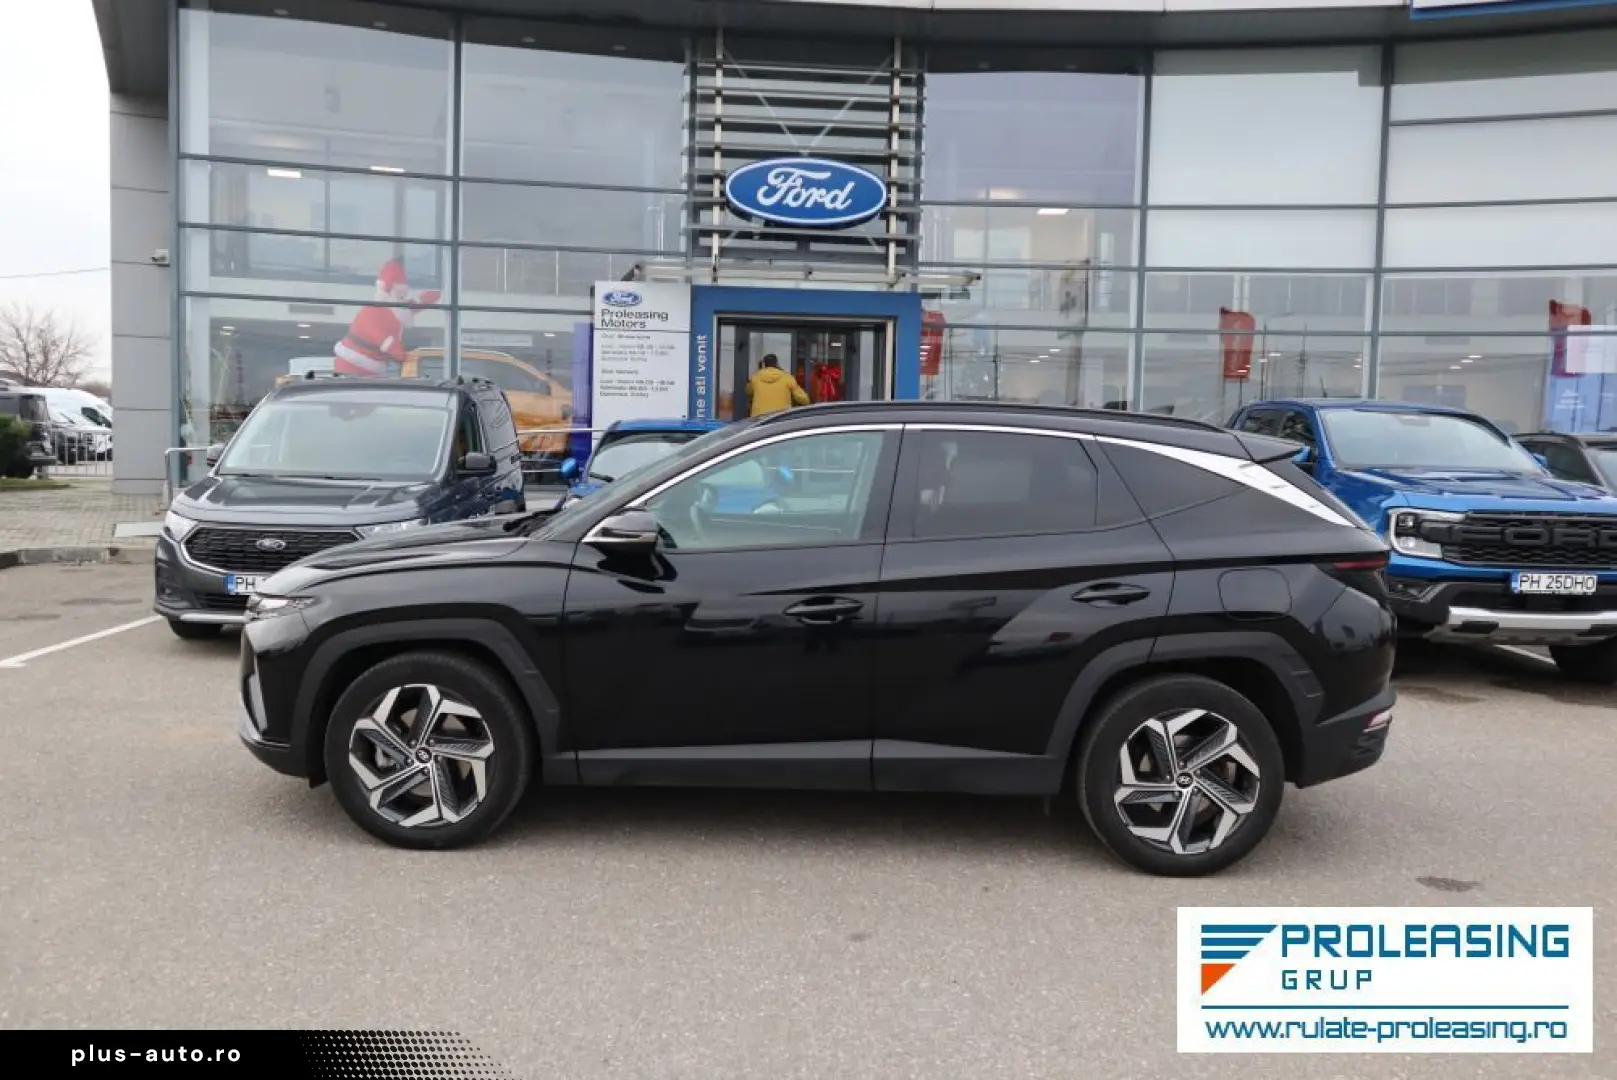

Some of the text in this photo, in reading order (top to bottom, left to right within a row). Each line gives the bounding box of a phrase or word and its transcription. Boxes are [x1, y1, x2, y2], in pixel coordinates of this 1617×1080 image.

[756, 167, 856, 210] Ford
[601, 308, 669, 322] Proleasing
[601, 318, 647, 329] Motors
[696, 334, 707, 373] venit
[696, 399, 706, 418] ne
[235, 576, 256, 591] PH
[1520, 575, 1541, 589] PH
